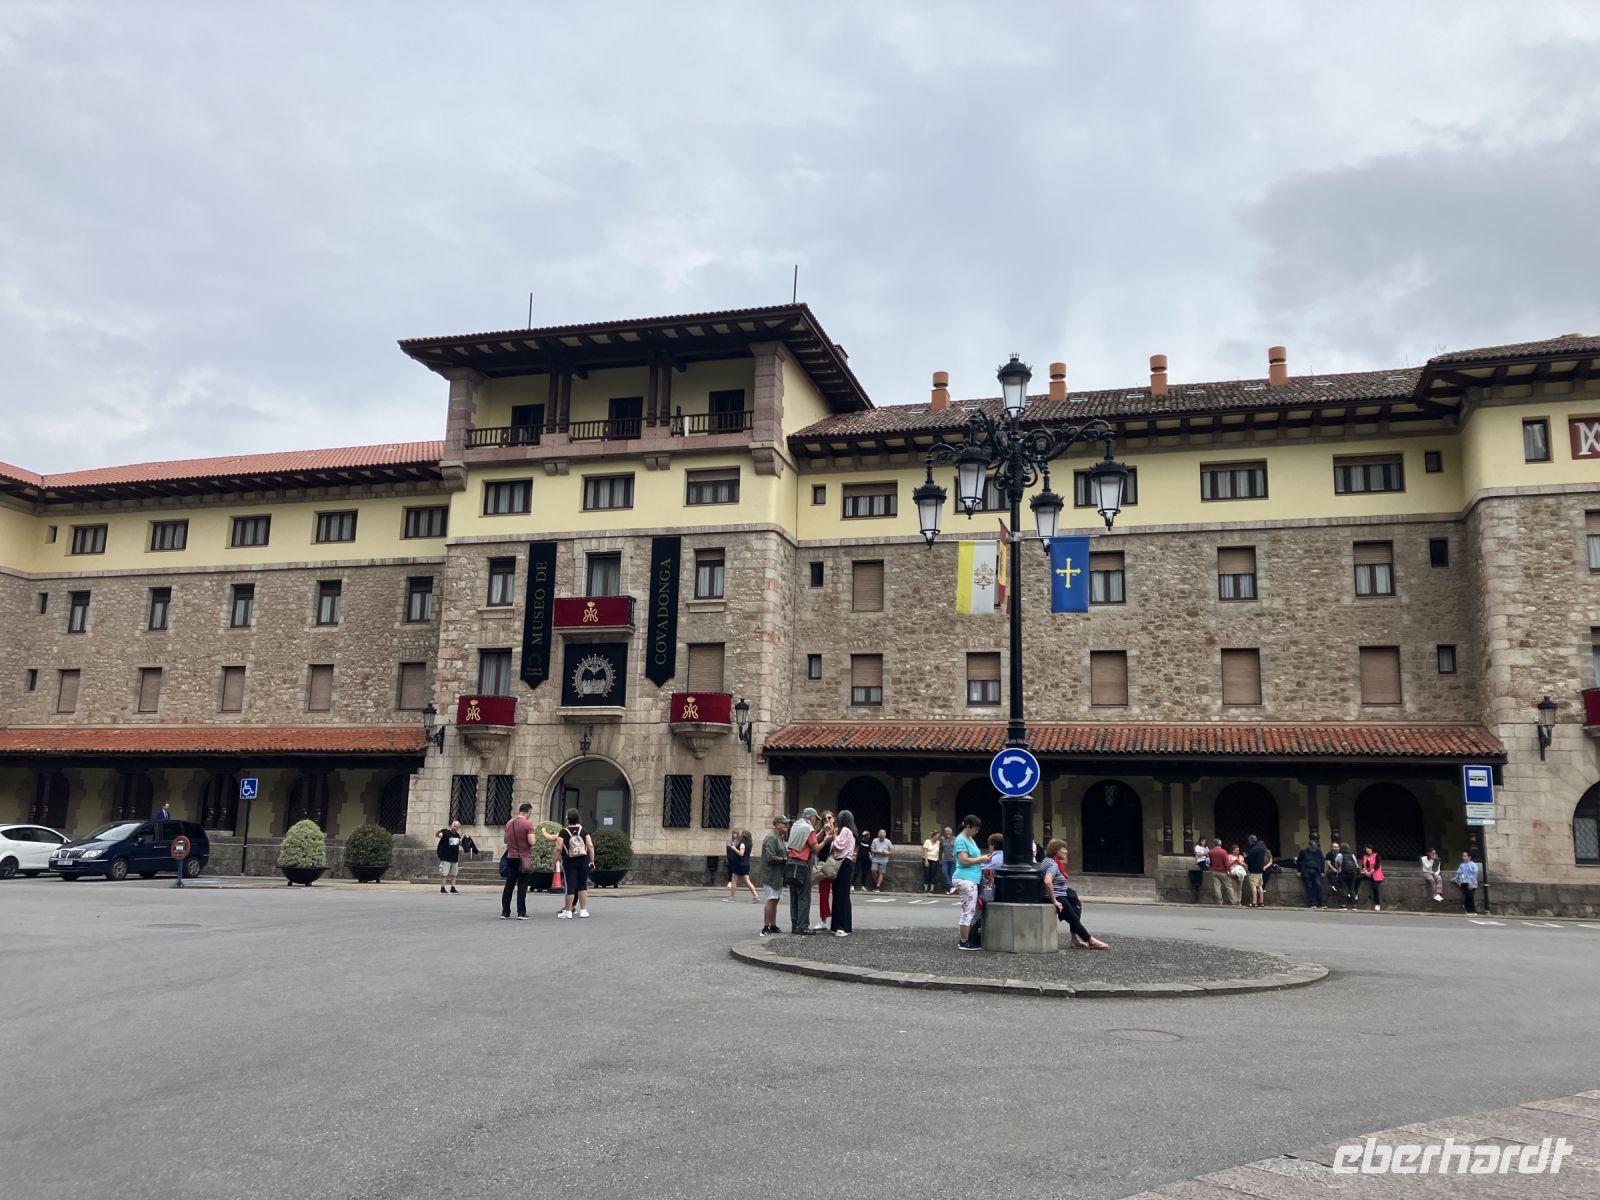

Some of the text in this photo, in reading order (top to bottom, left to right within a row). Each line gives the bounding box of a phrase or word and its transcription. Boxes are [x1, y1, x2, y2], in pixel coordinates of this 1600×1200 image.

[535, 561, 548, 582] DE
[531, 588, 546, 645] MUSEO
[655, 557, 671, 665] COVADONGA
